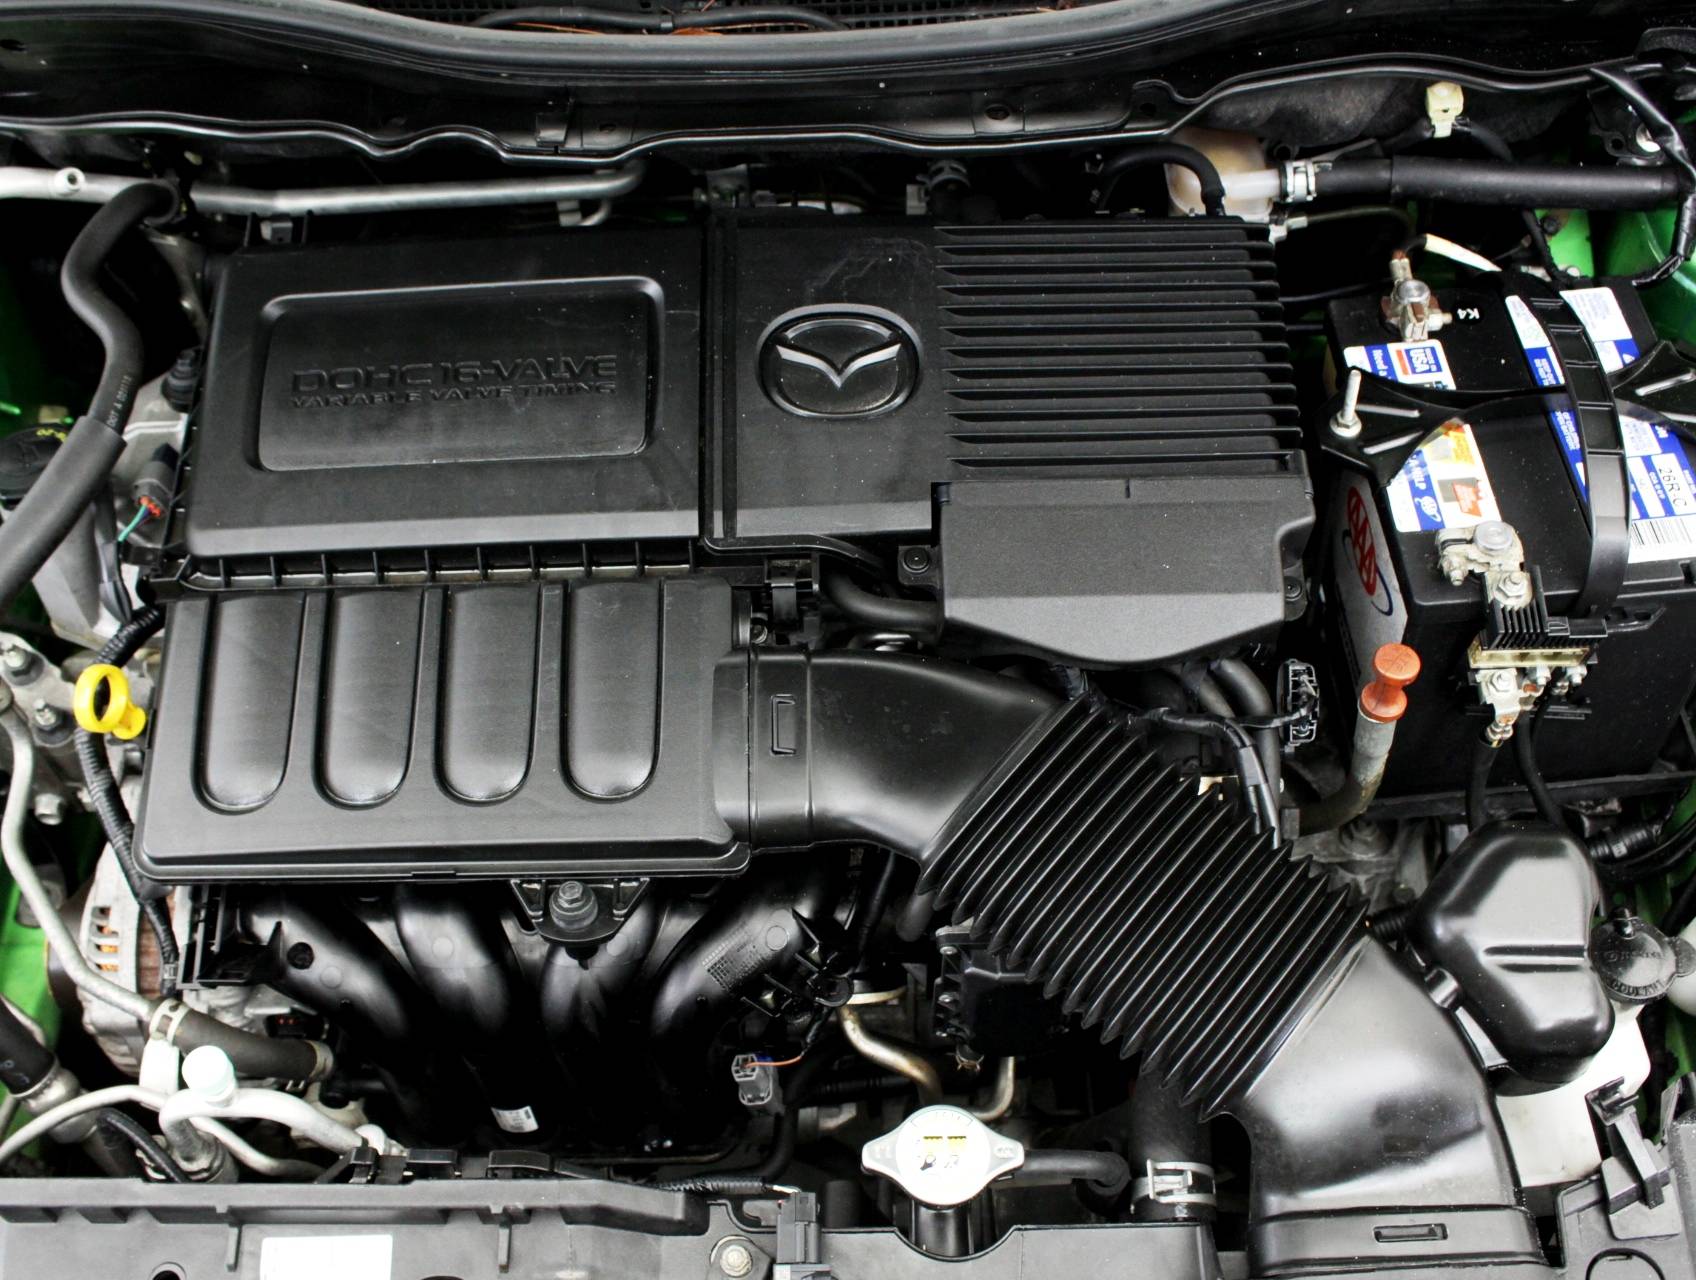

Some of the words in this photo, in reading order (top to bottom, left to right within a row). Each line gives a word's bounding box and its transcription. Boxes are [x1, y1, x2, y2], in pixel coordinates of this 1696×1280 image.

[292, 362, 432, 392] DOHC
[440, 355, 618, 385] 16-VALVE
[1373, 349, 1387, 370] Need
[1410, 348, 1430, 373] USA
[292, 390, 422, 408] VARIABLE
[429, 384, 513, 402] VALVE
[517, 380, 617, 397] TIMING
[1659, 467, 1687, 506] 26R-C
[1347, 487, 1379, 596] AAA
